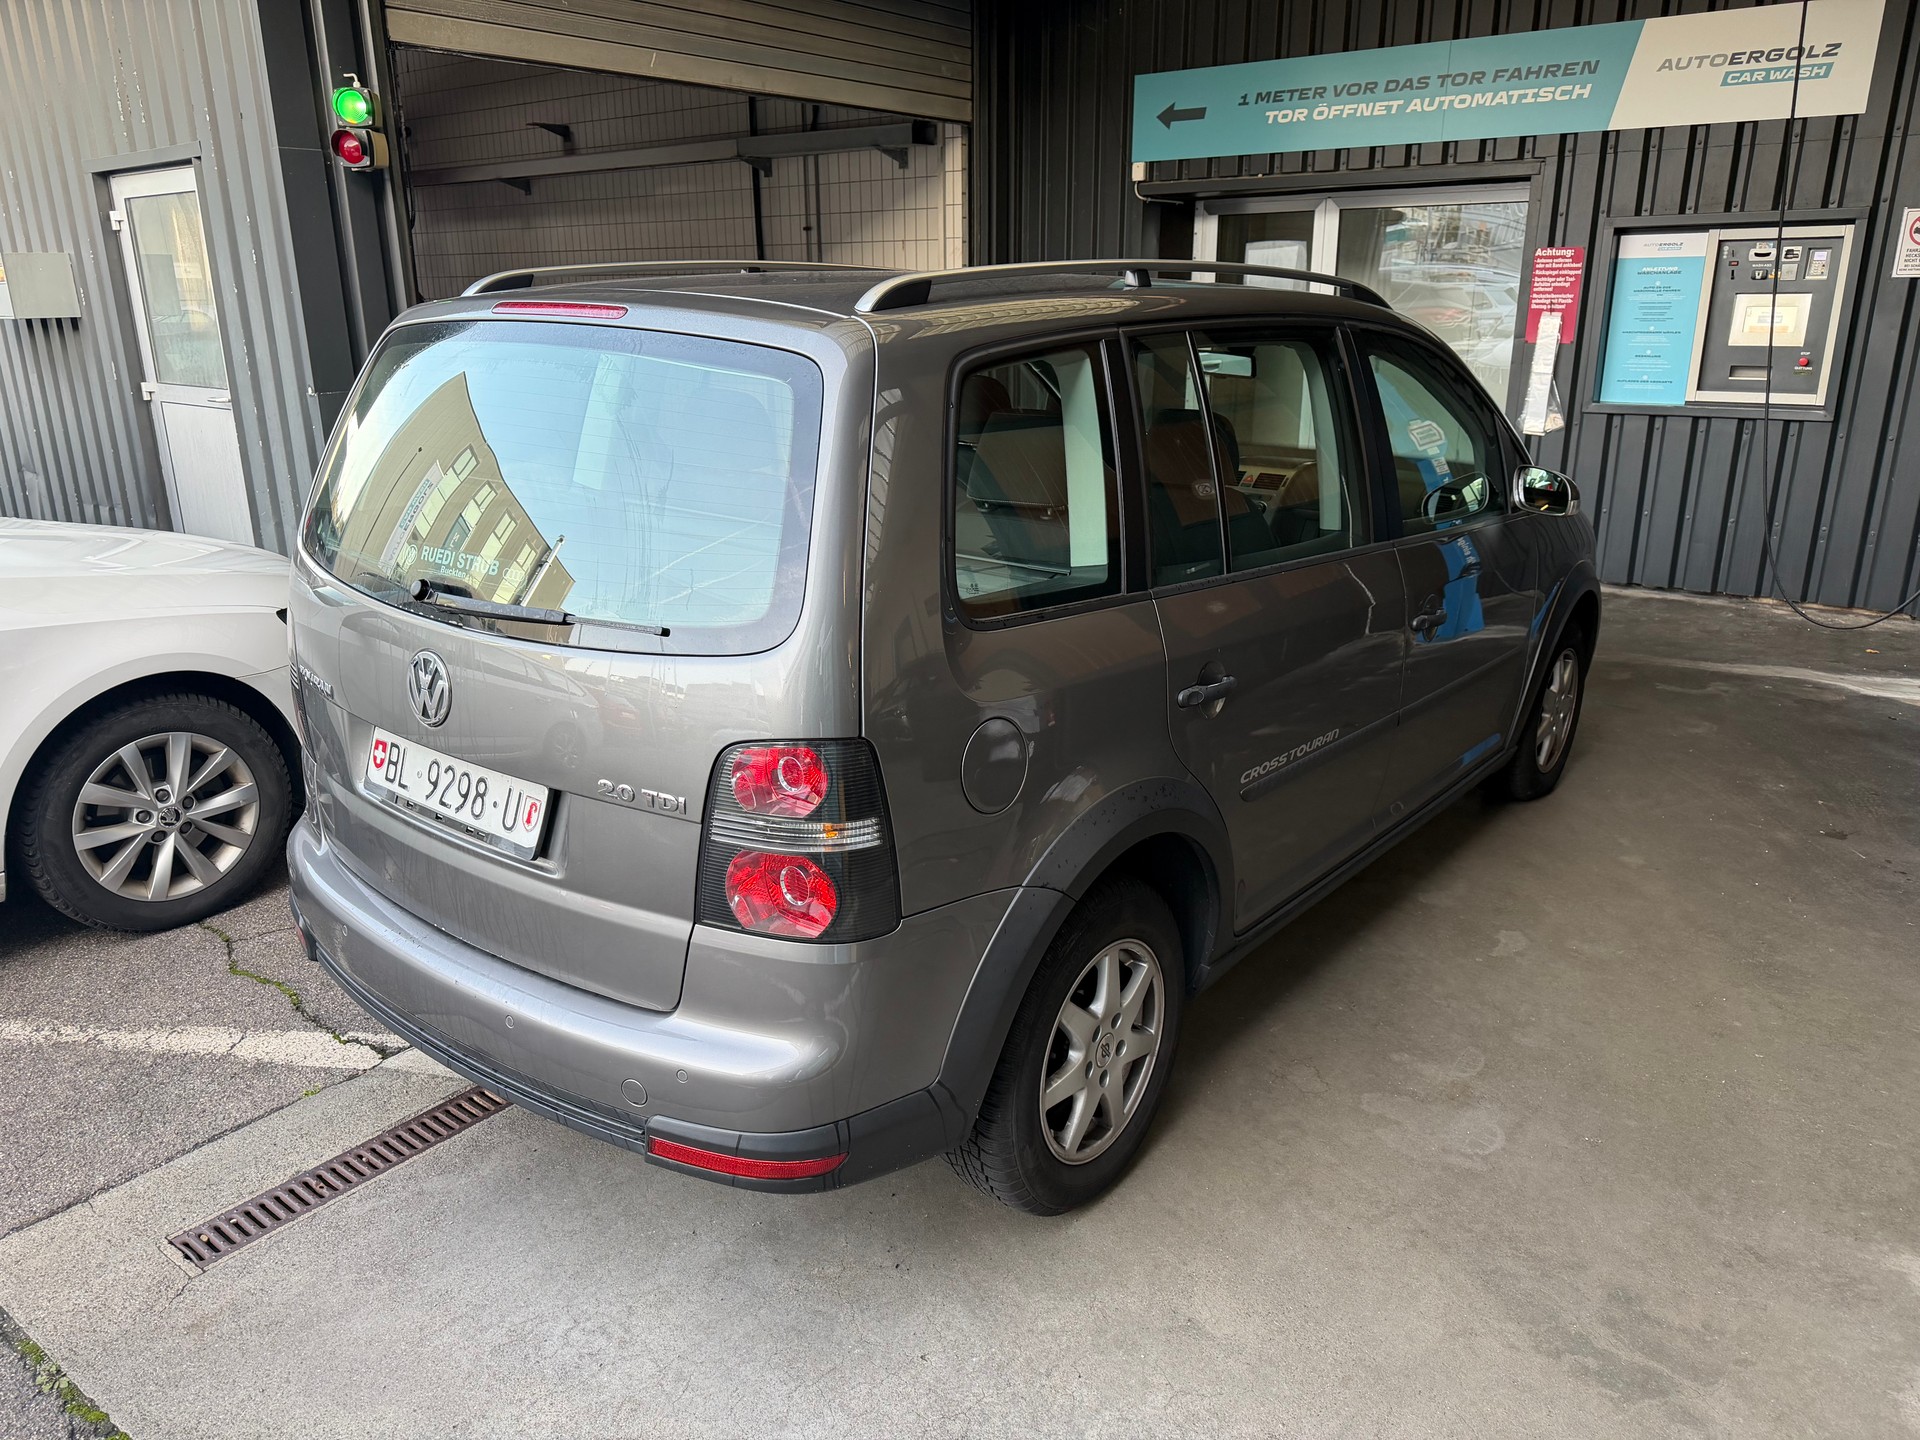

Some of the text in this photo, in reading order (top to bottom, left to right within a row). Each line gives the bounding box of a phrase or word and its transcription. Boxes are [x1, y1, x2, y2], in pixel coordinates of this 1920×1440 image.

[1656, 42, 1842, 72] AUTOERGOLZ
[1238, 59, 1600, 106] 1 METER VOR DAS TOR FAHREN
[1727, 66, 1825, 84] CAR WASH
[1265, 83, 1592, 124] TOR ÖFFNET AUTOMATISCH
[1535, 248, 1575, 257] Achtung:
[421, 545, 500, 577] RUEDI STRUB
[385, 741, 524, 832] BL 9298 U
[641, 788, 687, 815] TDI
